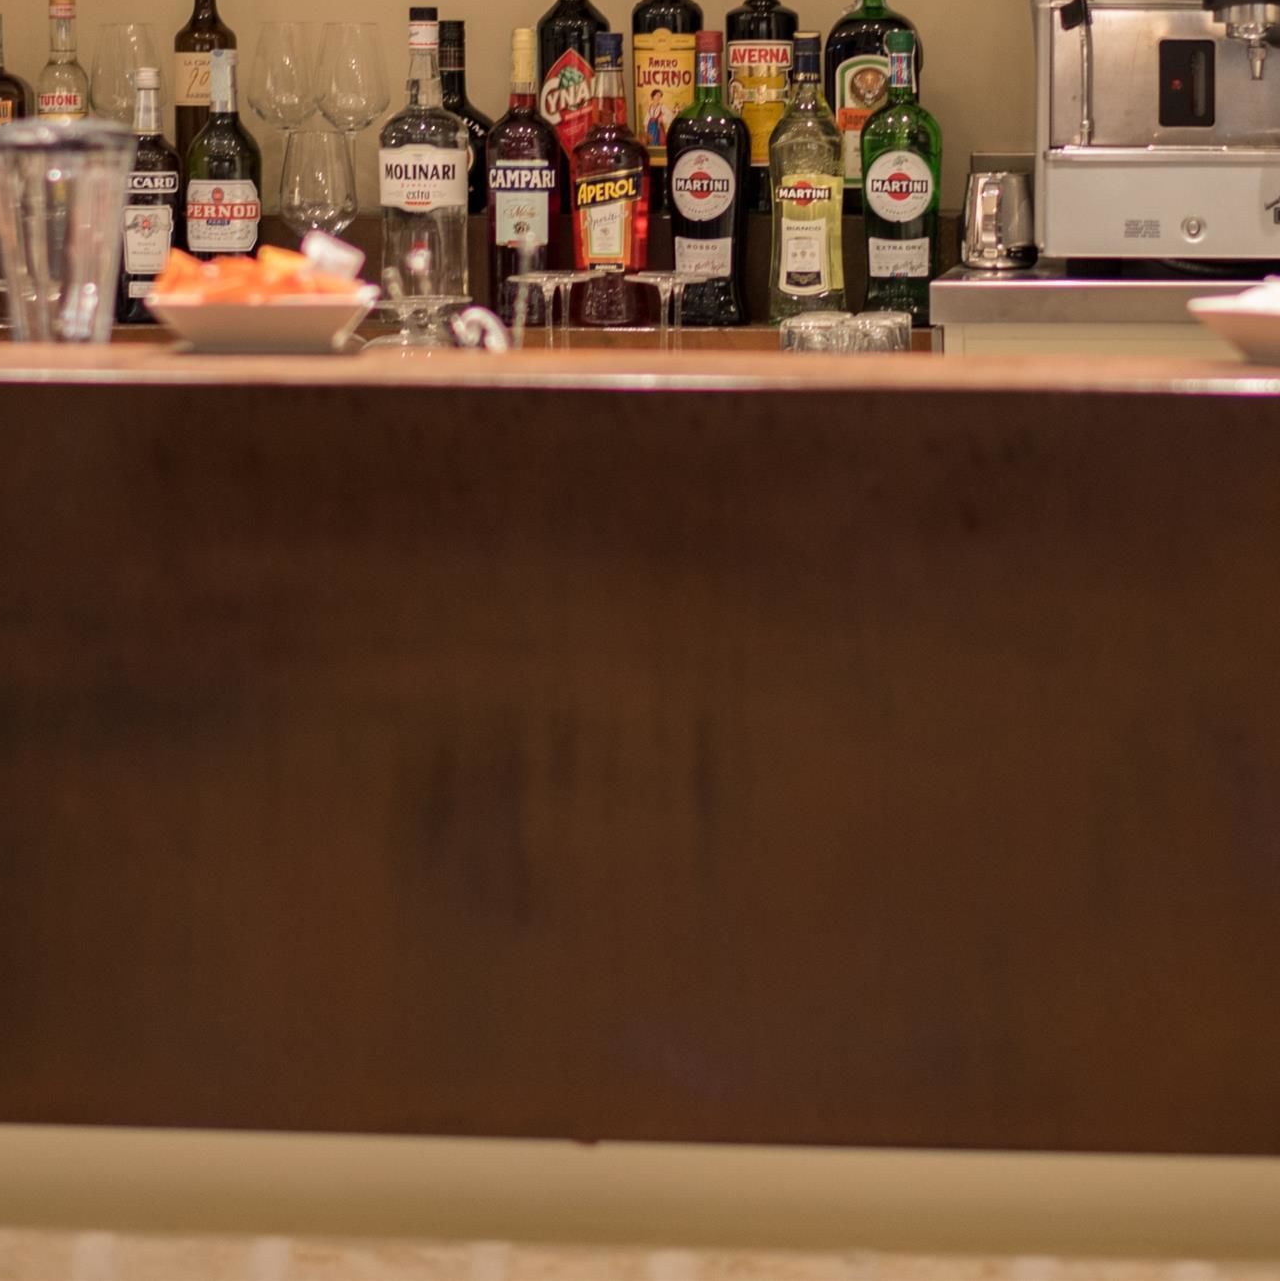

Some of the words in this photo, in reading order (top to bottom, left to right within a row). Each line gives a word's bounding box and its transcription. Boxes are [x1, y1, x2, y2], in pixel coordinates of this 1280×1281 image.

[648, 57, 678, 68] AMARO
[731, 48, 790, 64] AVERNA
[637, 65, 692, 88] LUCANO
[40, 95, 79, 107] TUTONE
[385, 163, 456, 180] MOLINARI
[128, 177, 175, 189] ICARD
[489, 168, 556, 189] CAMPARI
[676, 179, 728, 191] MARTINI
[577, 178, 636, 206] APEROL
[873, 180, 927, 193] MARTINI
[779, 188, 830, 199] MARTINI
[188, 204, 257, 218] PERNOD
